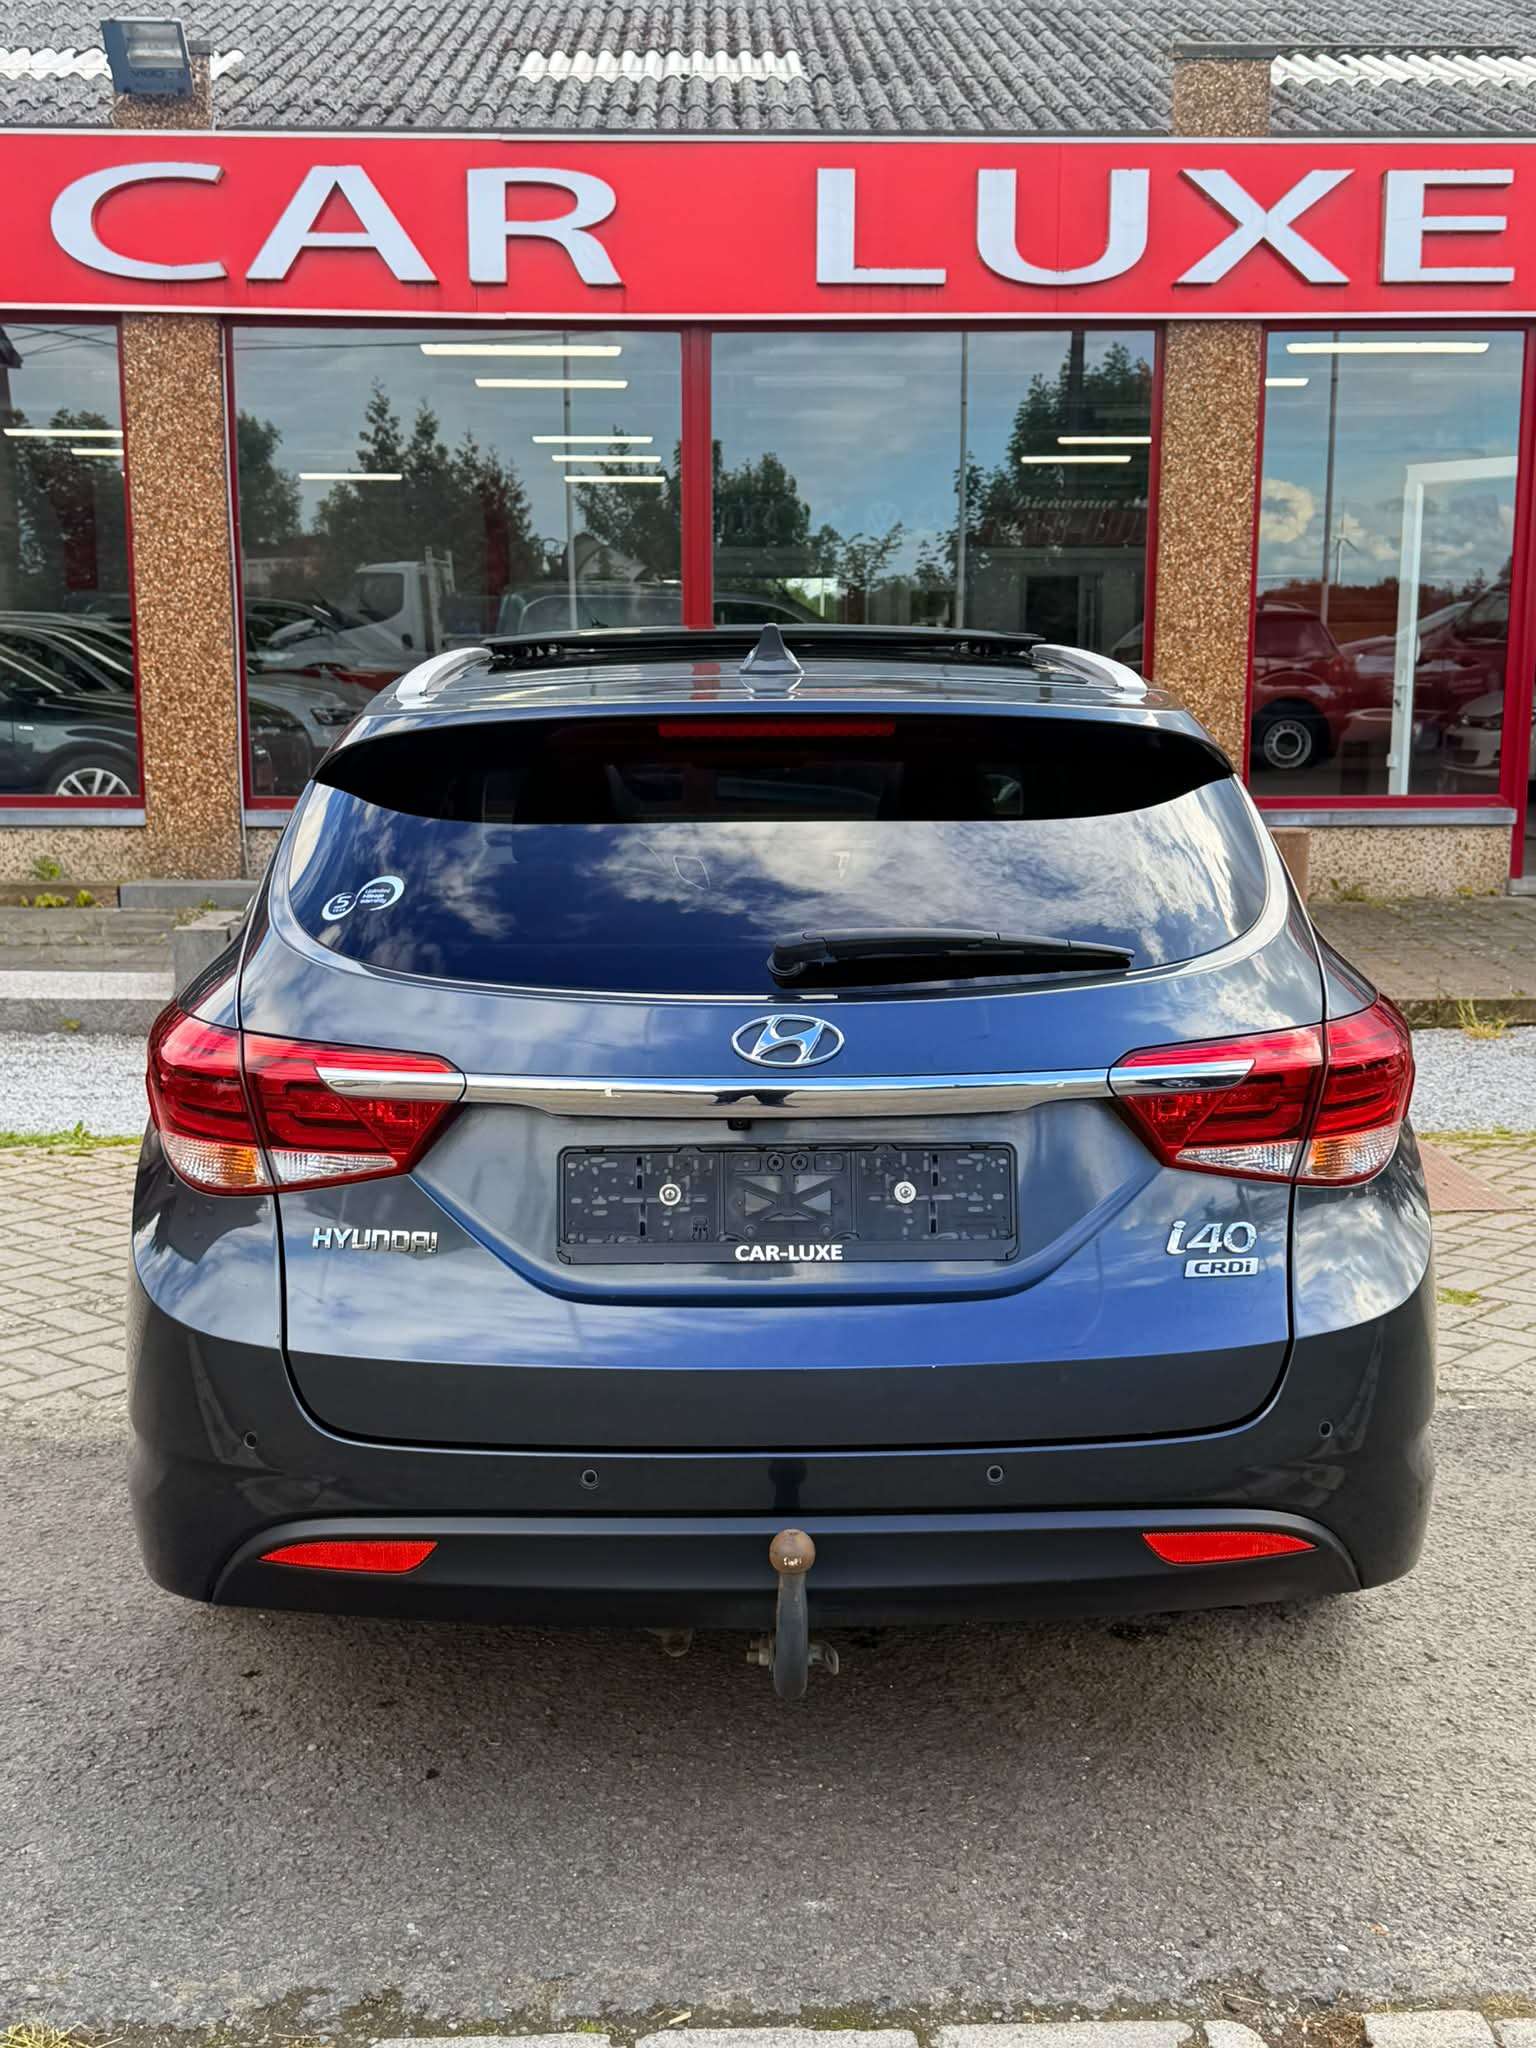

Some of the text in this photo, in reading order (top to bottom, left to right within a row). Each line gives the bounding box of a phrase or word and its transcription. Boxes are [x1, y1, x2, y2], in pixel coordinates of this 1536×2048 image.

[50, 161, 1516, 286] CAR LUXE
[311, 1227, 438, 1253] HYUNDAI
[1166, 1220, 1258, 1255] i40
[734, 1244, 843, 1262] CAR-LUXE
[1193, 1260, 1252, 1275] CRDi
